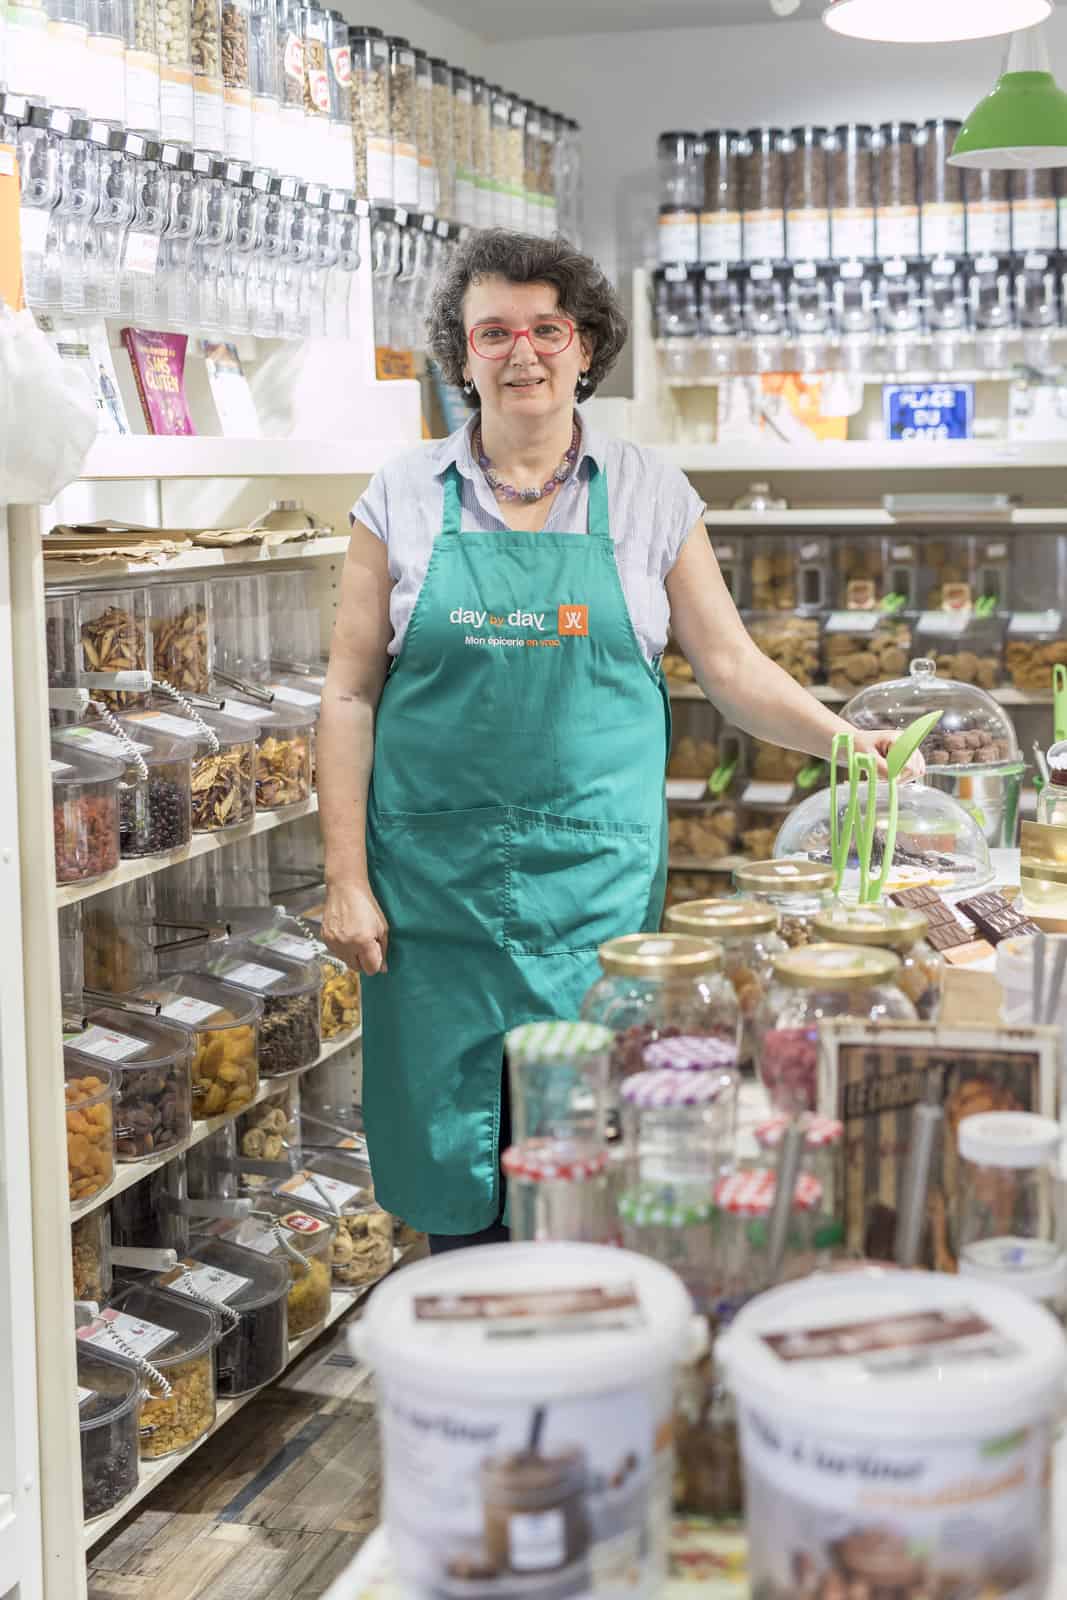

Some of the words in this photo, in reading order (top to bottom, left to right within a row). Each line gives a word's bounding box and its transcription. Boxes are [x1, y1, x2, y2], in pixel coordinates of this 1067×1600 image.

[450, 607, 487, 628] day
[489, 615, 504, 627] by
[508, 609, 545, 631] day
[465, 636, 486, 645] Mon
[526, 639, 538, 647] en
